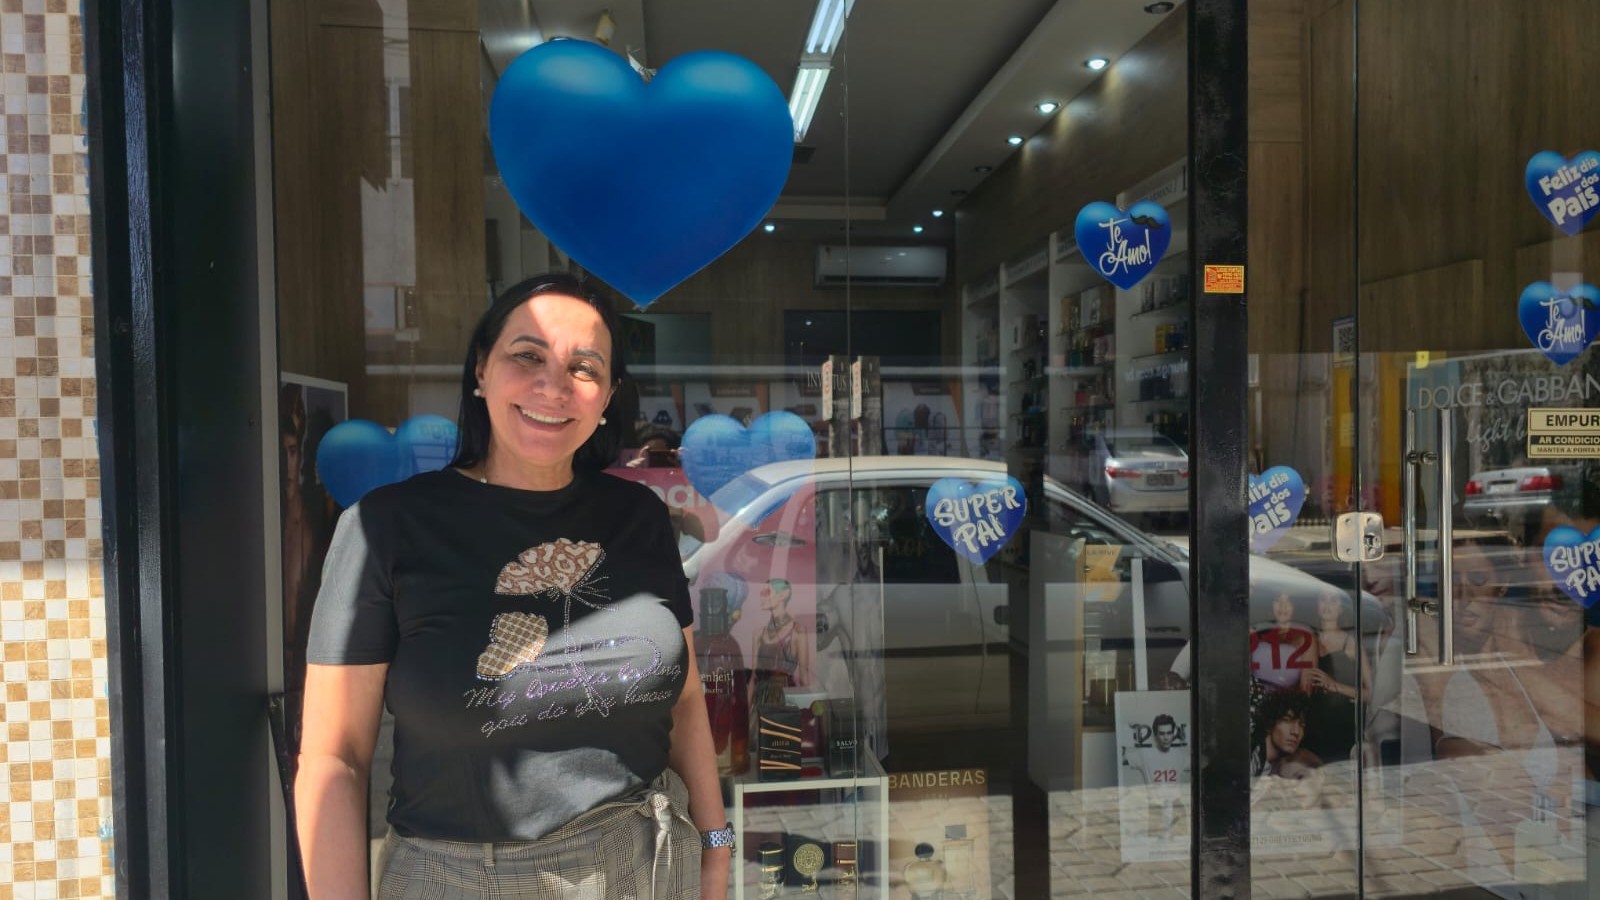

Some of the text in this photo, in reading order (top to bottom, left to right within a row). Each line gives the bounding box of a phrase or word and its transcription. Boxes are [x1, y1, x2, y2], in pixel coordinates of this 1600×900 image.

[1539, 157, 1599, 196] Feliz dia
[1581, 173, 1599, 188] dos
[1098, 217, 1128, 252] Te
[1099, 228, 1152, 276] Amo!
[1538, 309, 1586, 351] Amo!
[806, 370, 847, 393] INVTUS
[1418, 382, 1483, 410] DOLCE
[1539, 436, 1552, 444] AR
[1248, 473, 1290, 506] liz dia
[1270, 487, 1291, 504] dos
[934, 485, 1021, 527] SUPER
[888, 769, 985, 789] BANDERAS
[1153, 769, 1177, 783] 212
